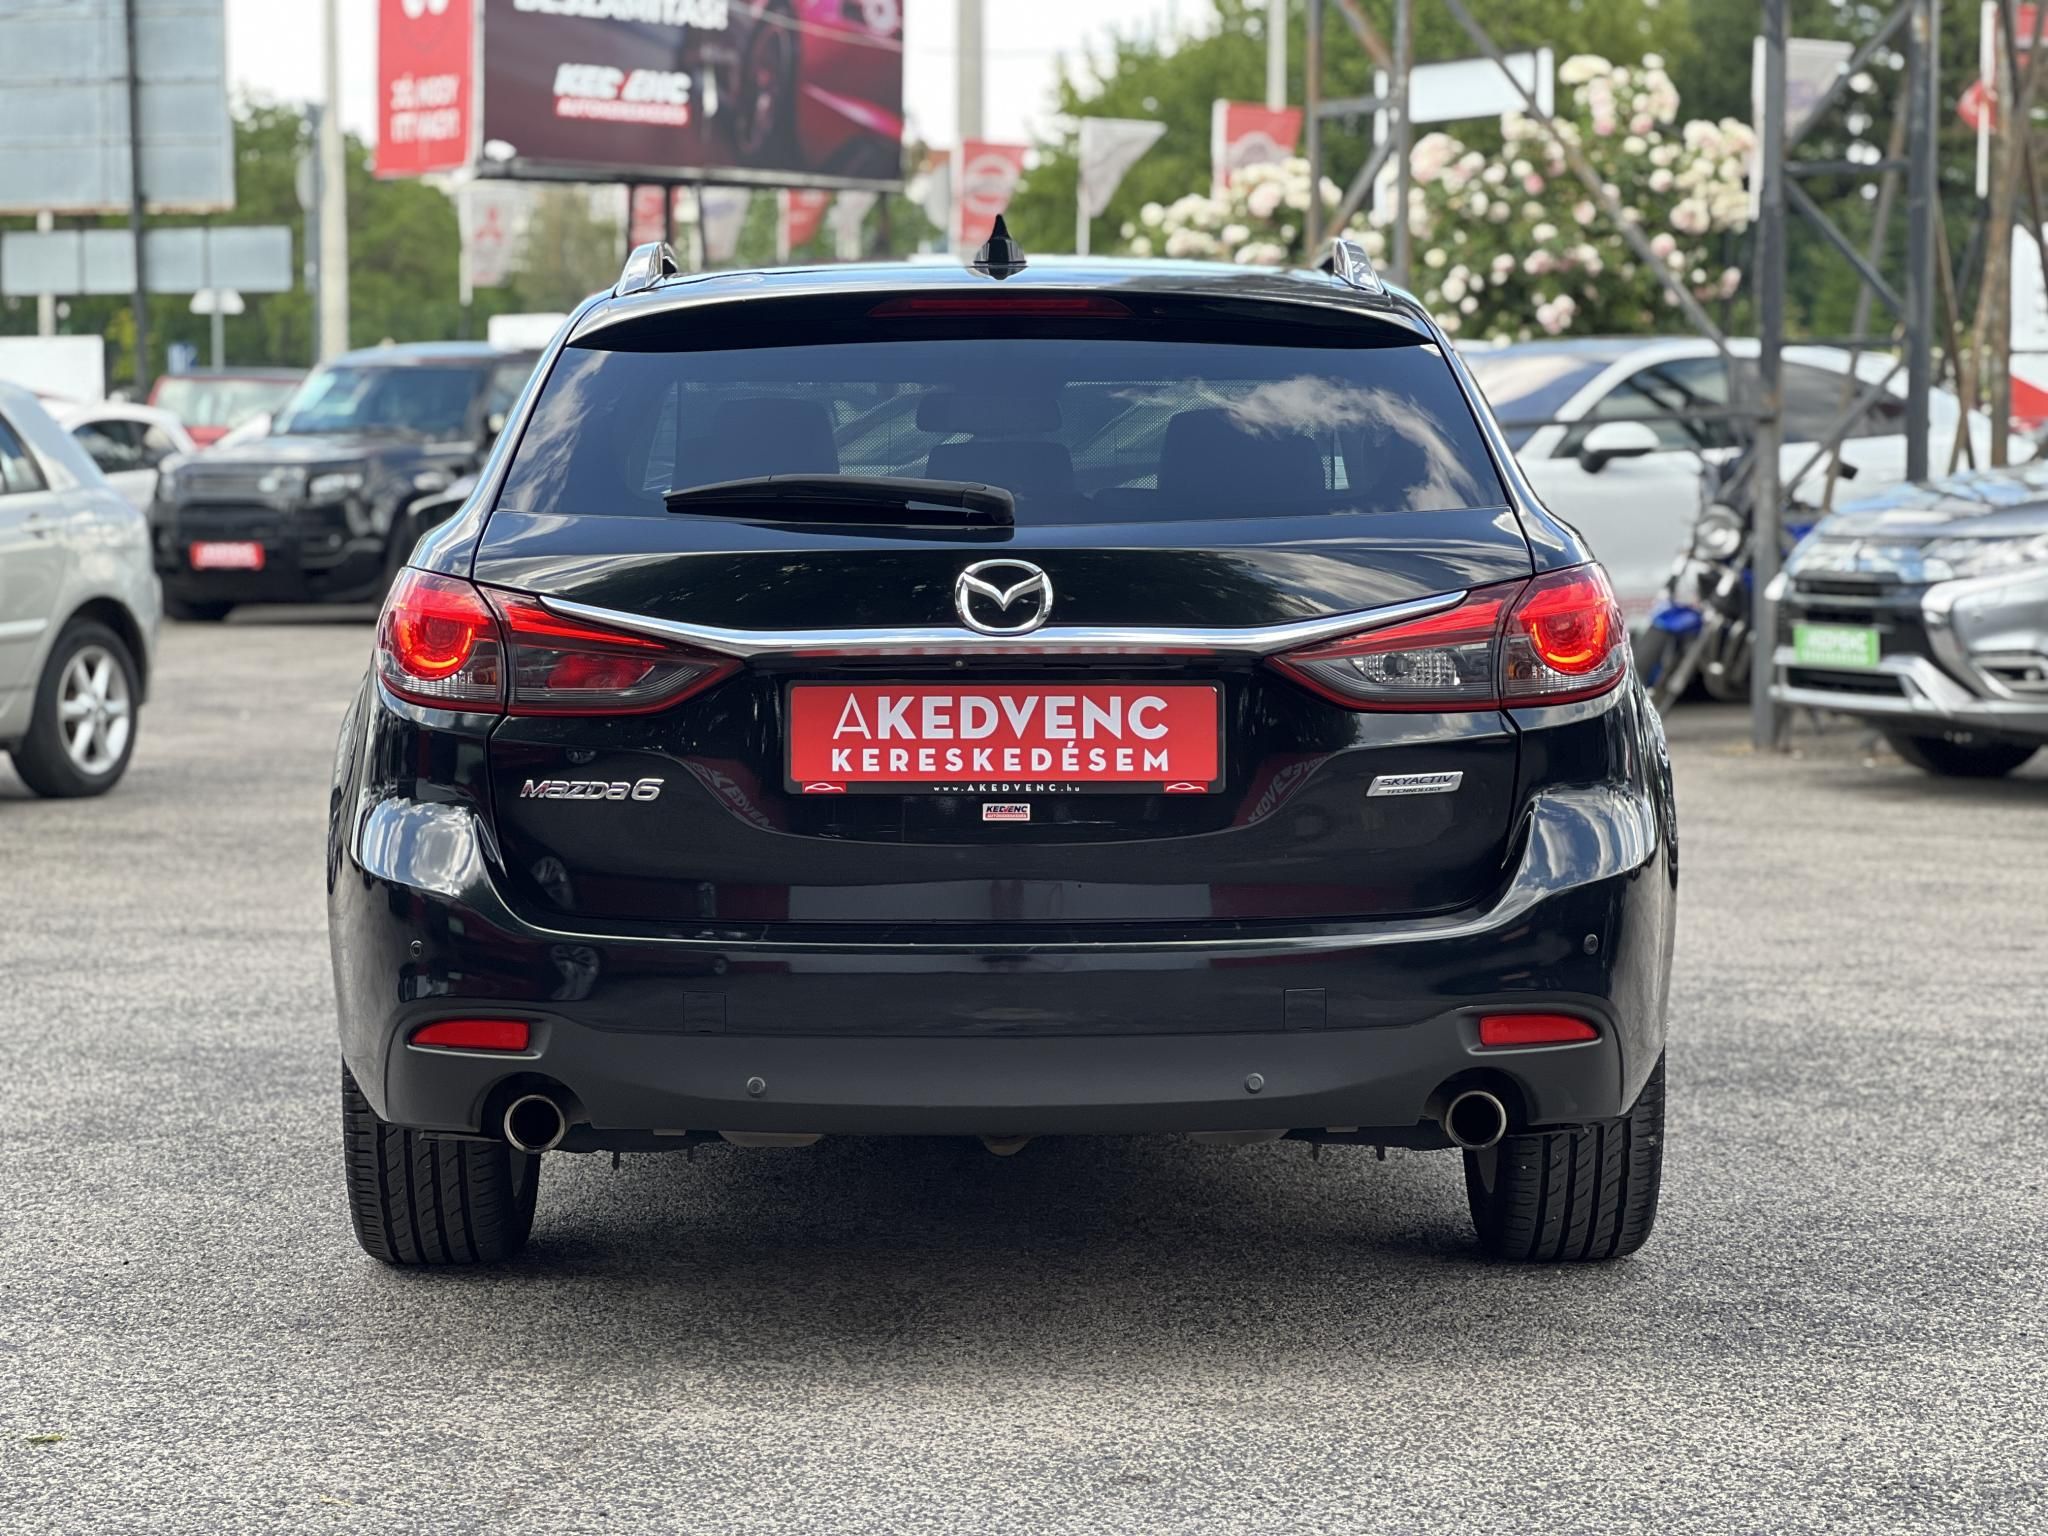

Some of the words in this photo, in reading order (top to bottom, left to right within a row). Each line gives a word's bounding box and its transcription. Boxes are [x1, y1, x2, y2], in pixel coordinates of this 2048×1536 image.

[831, 741, 1170, 772] KERESKEDÉSEM
[1380, 775, 1454, 786] SKYACTIV
[933, 783, 1080, 792] www.AKEDVENC.hu
[1386, 786, 1442, 794] TECHNOLOGY
